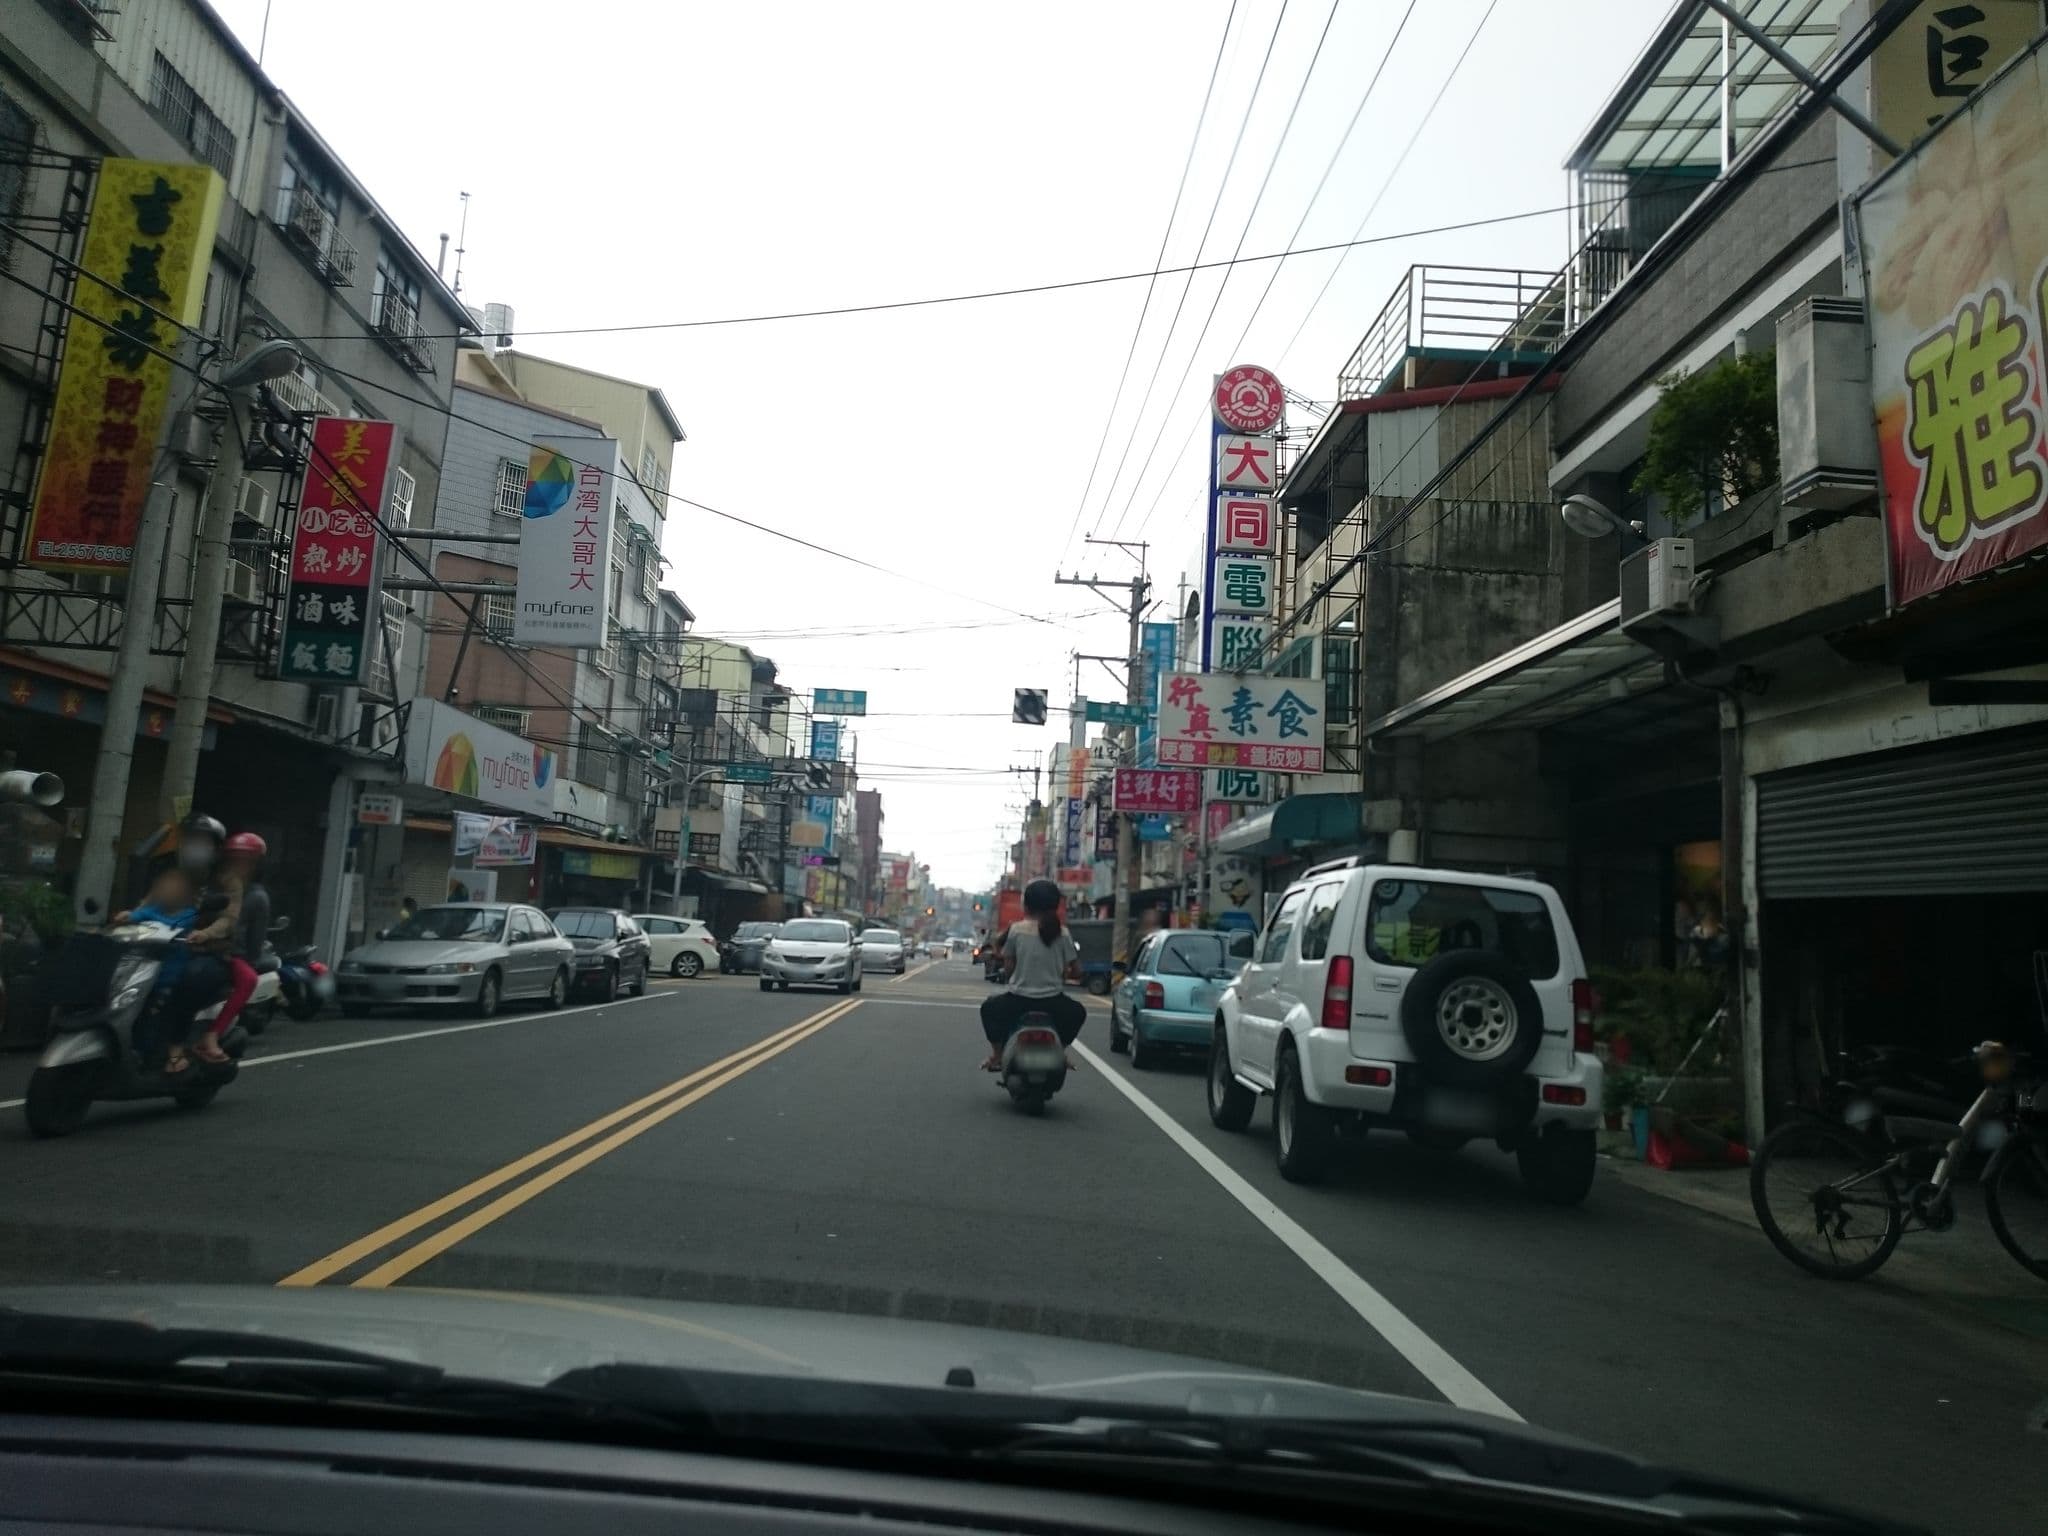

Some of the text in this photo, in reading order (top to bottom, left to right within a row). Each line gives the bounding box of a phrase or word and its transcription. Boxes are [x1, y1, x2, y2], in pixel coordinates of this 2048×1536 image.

[1220, 401, 1265, 429] TATUNG
[323, 422, 371, 507] 美食
[302, 507, 376, 537] 小吃部
[303, 543, 367, 577] 熱炒
[296, 592, 360, 626] 滷味
[524, 601, 594, 617] myfone
[291, 642, 353, 675] 飯麵
[482, 757, 530, 790] myfone
